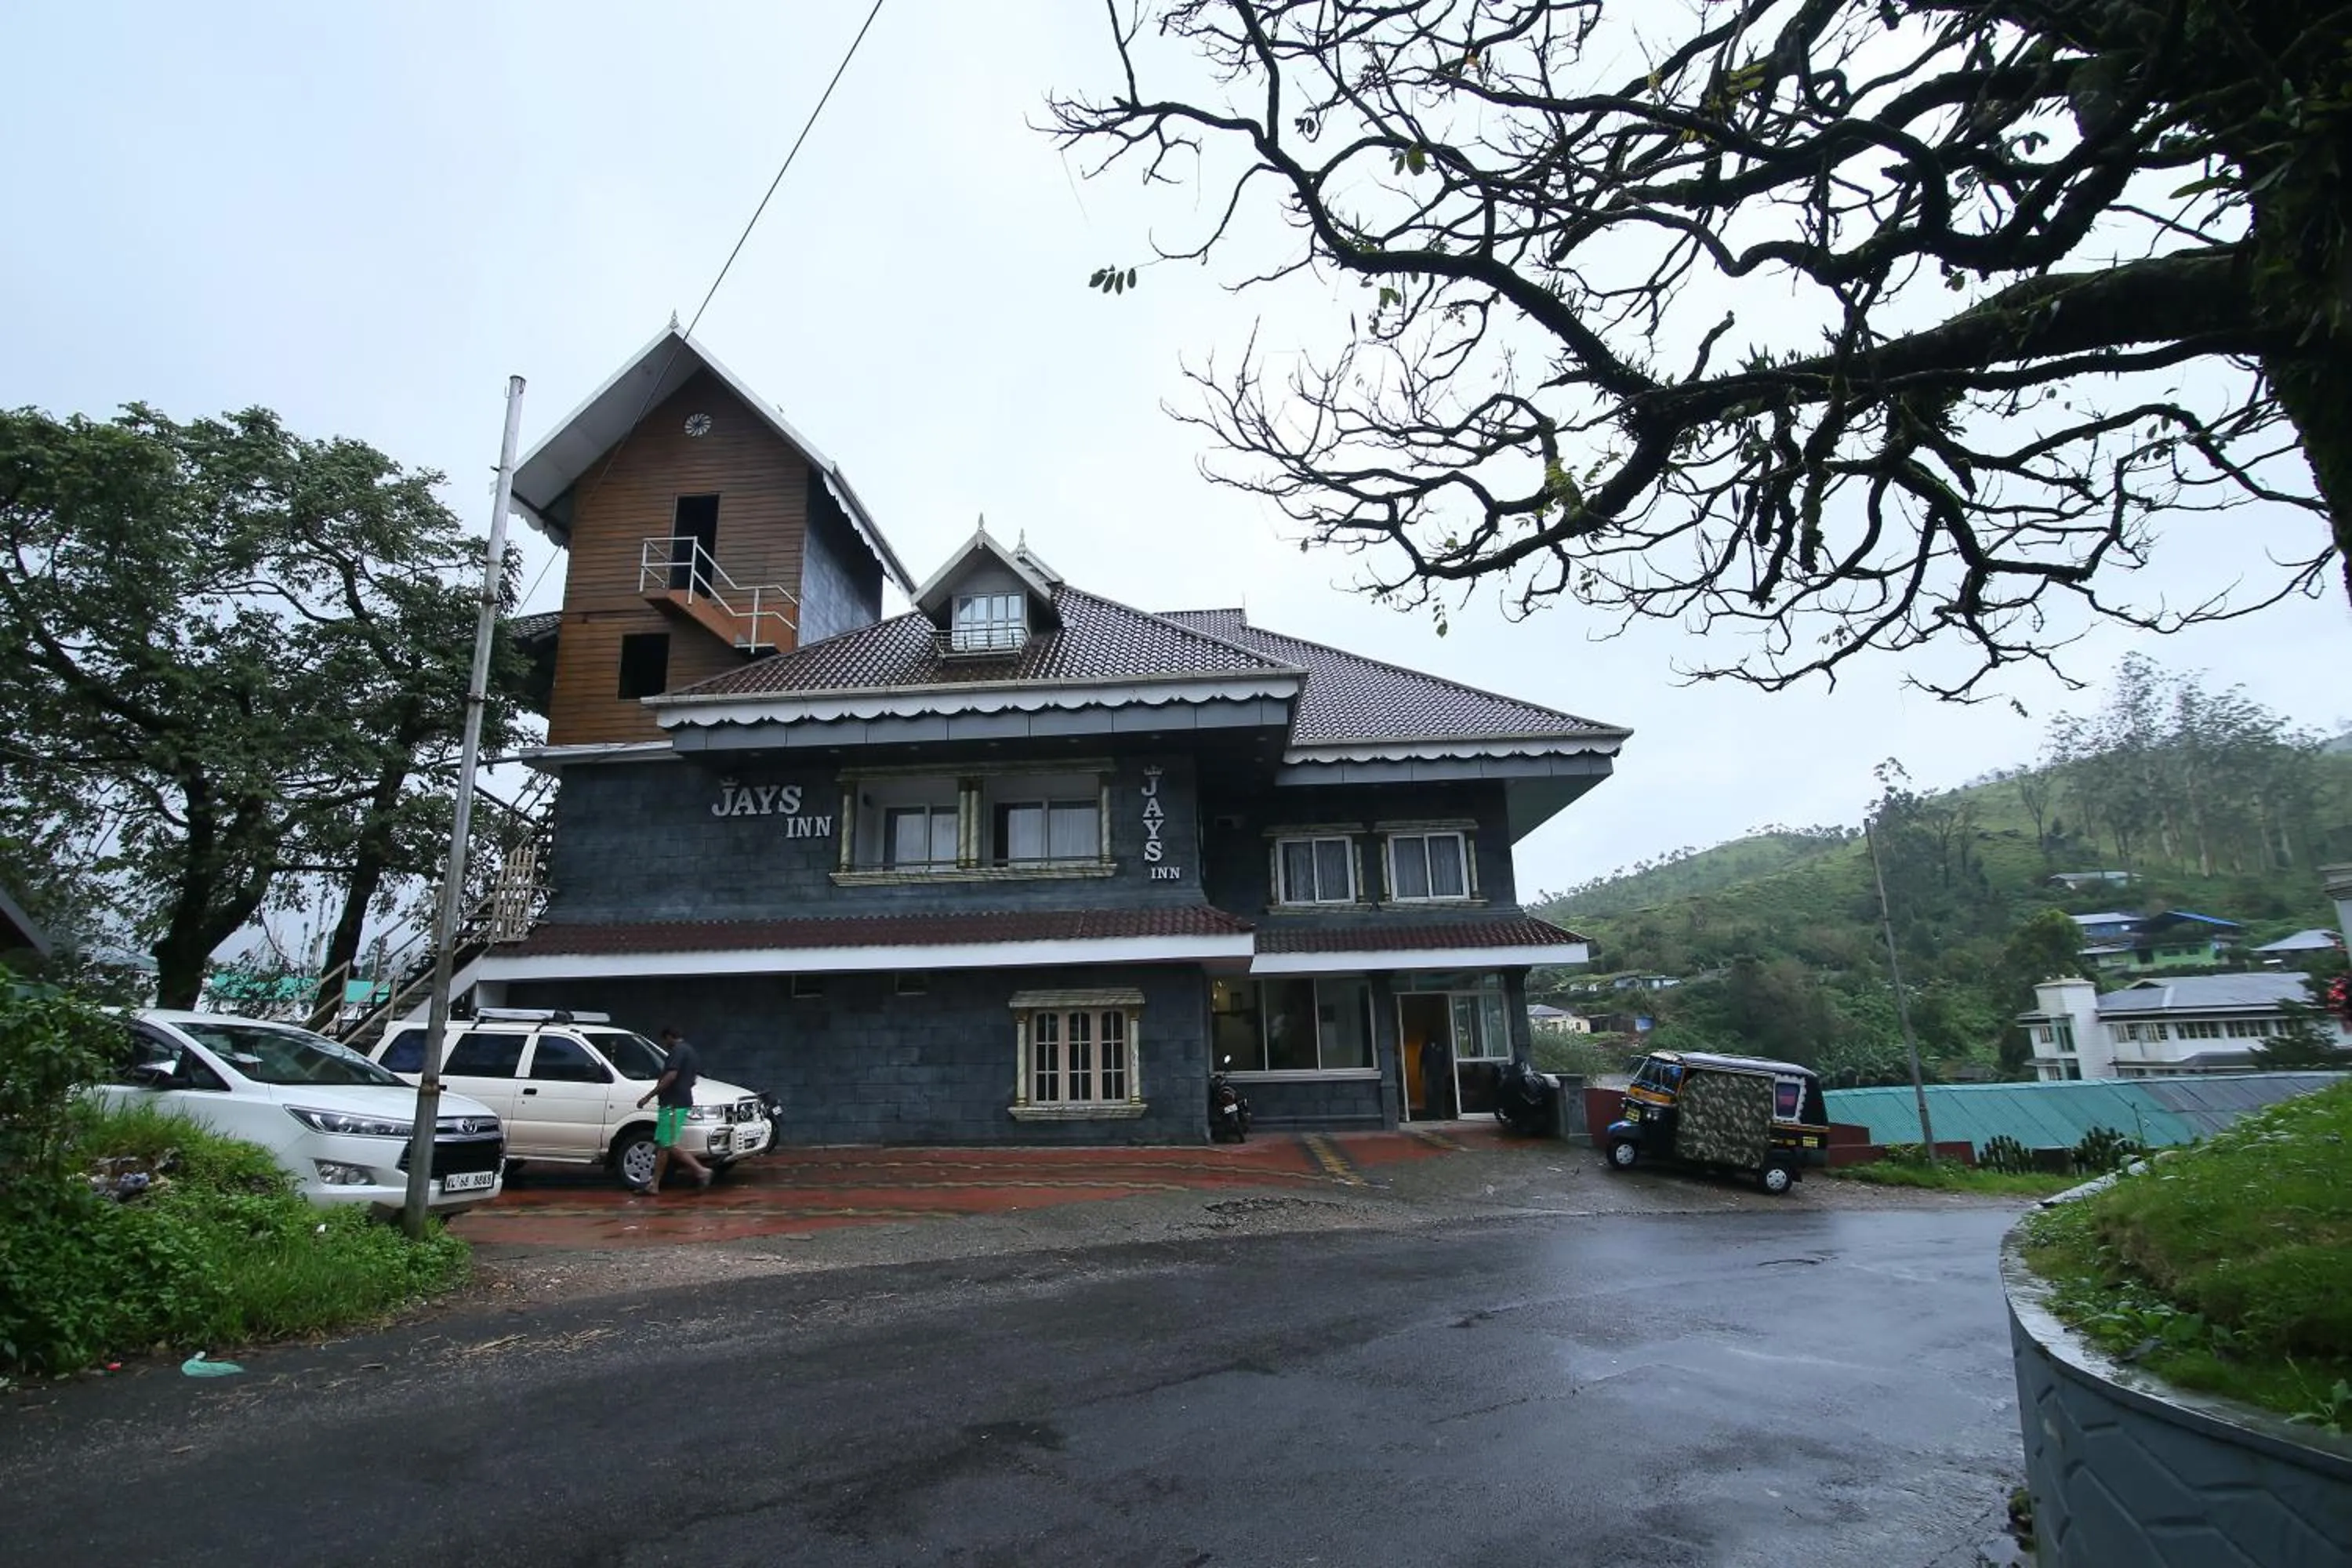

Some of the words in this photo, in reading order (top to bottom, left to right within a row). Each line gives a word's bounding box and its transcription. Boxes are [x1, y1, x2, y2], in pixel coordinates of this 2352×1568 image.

[711, 785, 803, 817] JAYS
[786, 815, 833, 839] INN
[1141, 775, 1165, 862] JAYS
[1150, 866, 1181, 880] INN
